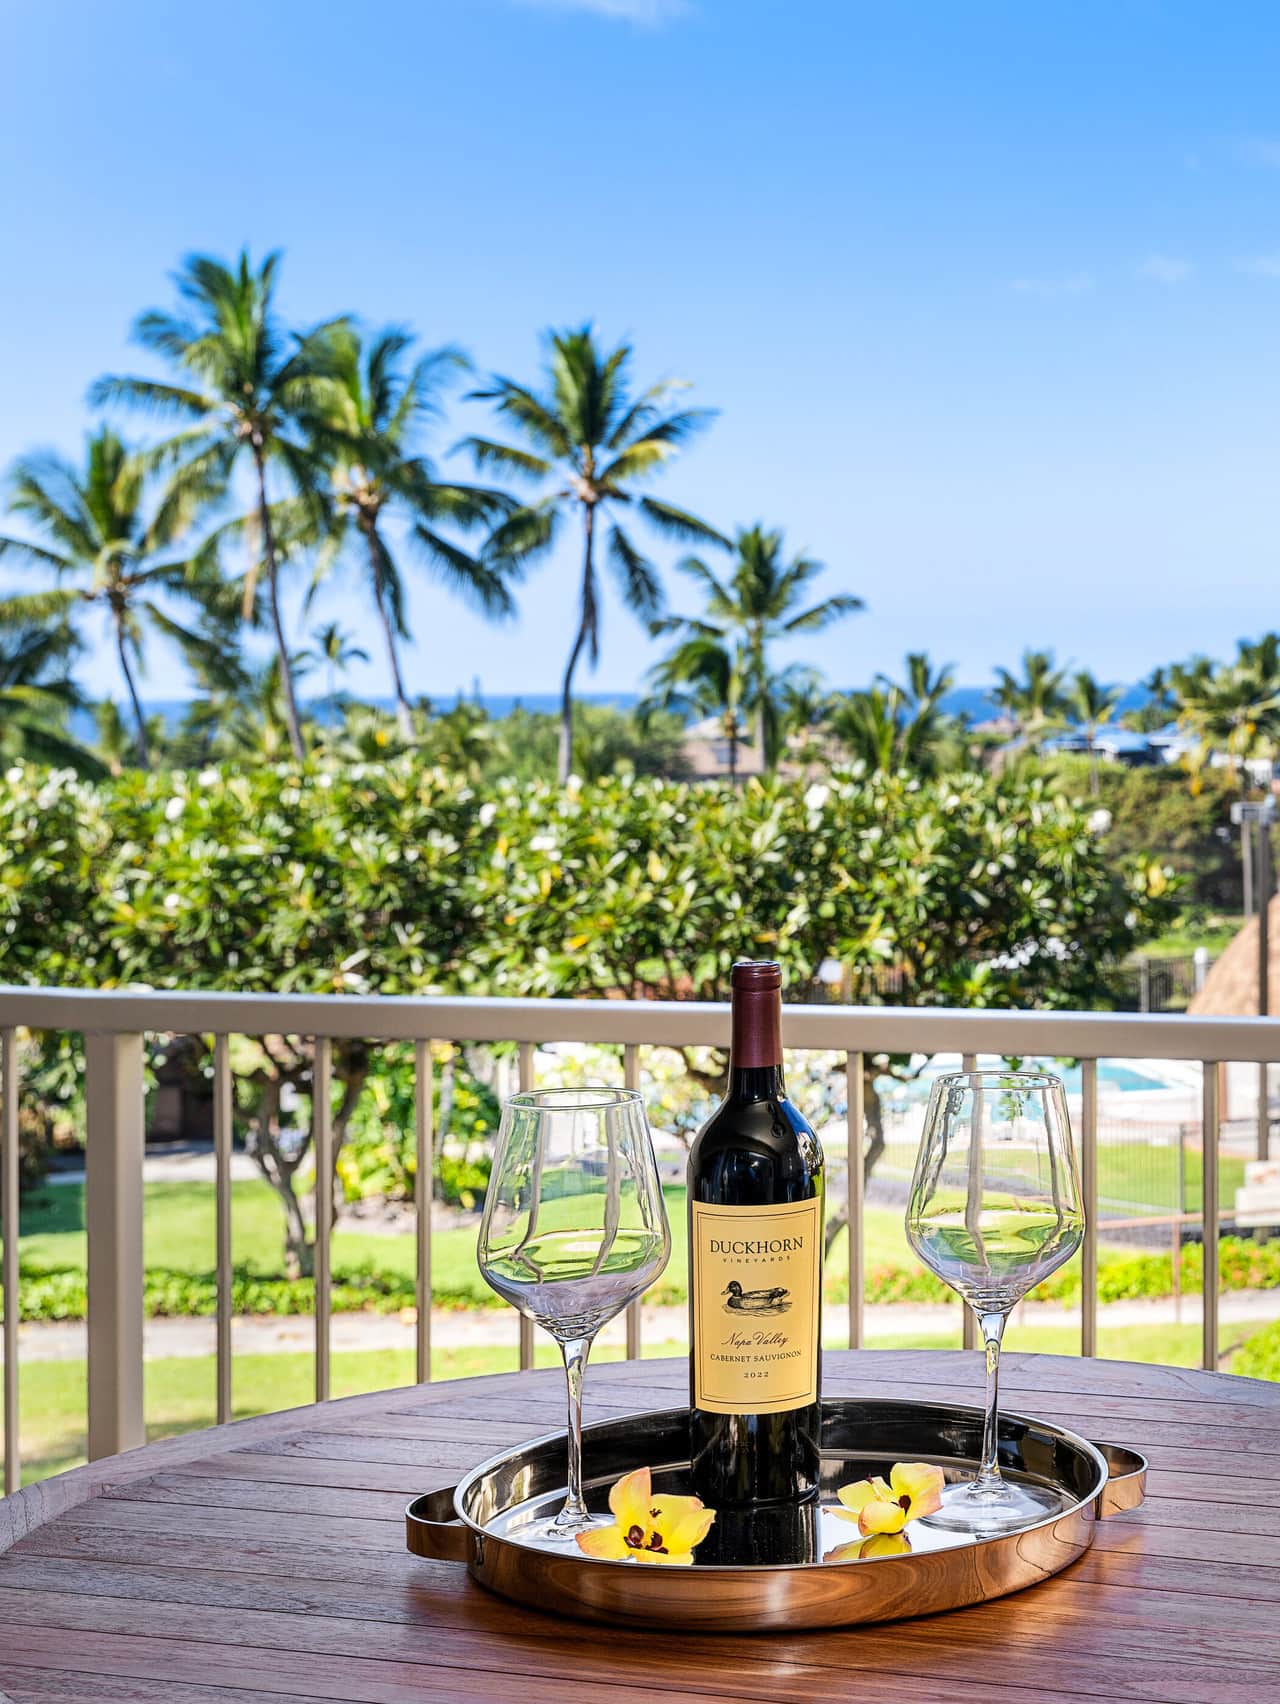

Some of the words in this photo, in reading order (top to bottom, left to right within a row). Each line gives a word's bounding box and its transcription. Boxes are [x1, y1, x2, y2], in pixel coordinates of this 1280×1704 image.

[710, 1236, 803, 1254] DUCKHORN
[722, 1255, 790, 1263] VINEYARDS
[721, 1331, 752, 1349] Napa
[752, 1331, 789, 1348] Valley
[710, 1353, 751, 1363] CABERNET
[753, 1350, 802, 1362] SAUVIGNON
[743, 1371, 769, 1379] 2022
